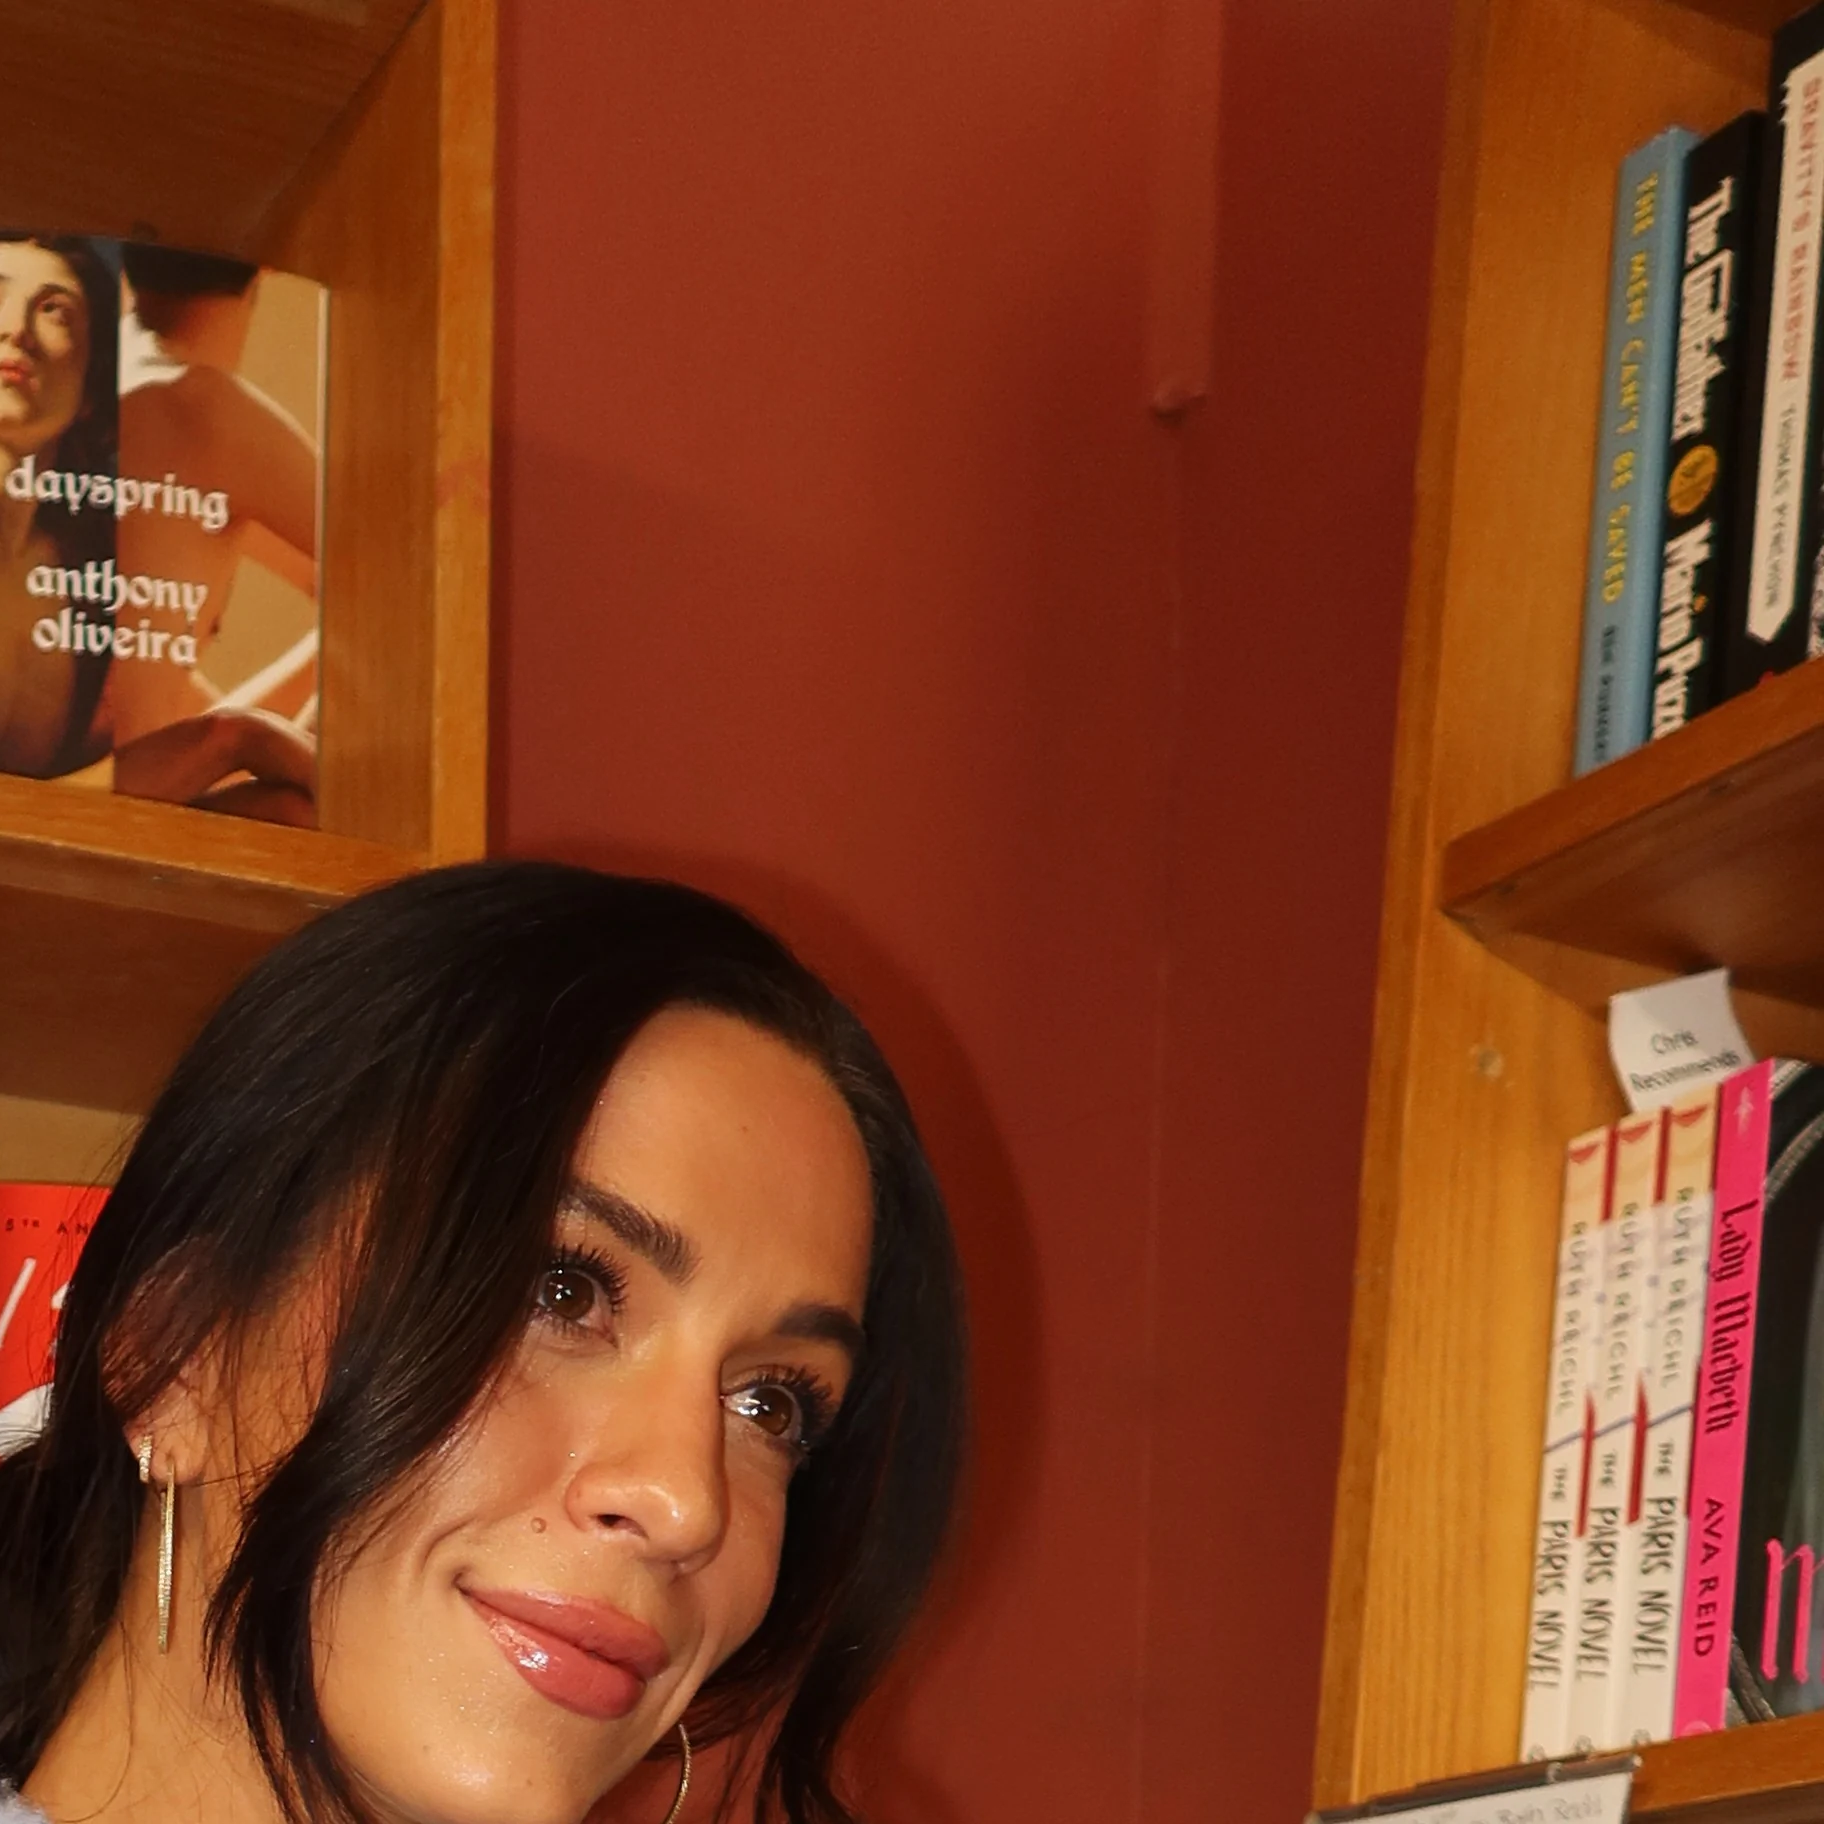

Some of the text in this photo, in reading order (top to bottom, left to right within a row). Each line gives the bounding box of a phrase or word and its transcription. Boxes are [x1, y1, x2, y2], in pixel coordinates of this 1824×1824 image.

[1688, 175, 1733, 266] The
[1672, 248, 1735, 441] Godfather
[6, 454, 230, 530] dayspring
[25, 559, 207, 620] anthony
[31, 615, 198, 664] oliveira
[1650, 1029, 1698, 1055] Chris
[1668, 1188, 1694, 1278] RUTH
[1693, 1199, 1760, 1659] Lady Macbeth AVA REID
[1638, 1496, 1678, 1576] PARIS
[1632, 1586, 1670, 1675] NOVEL
